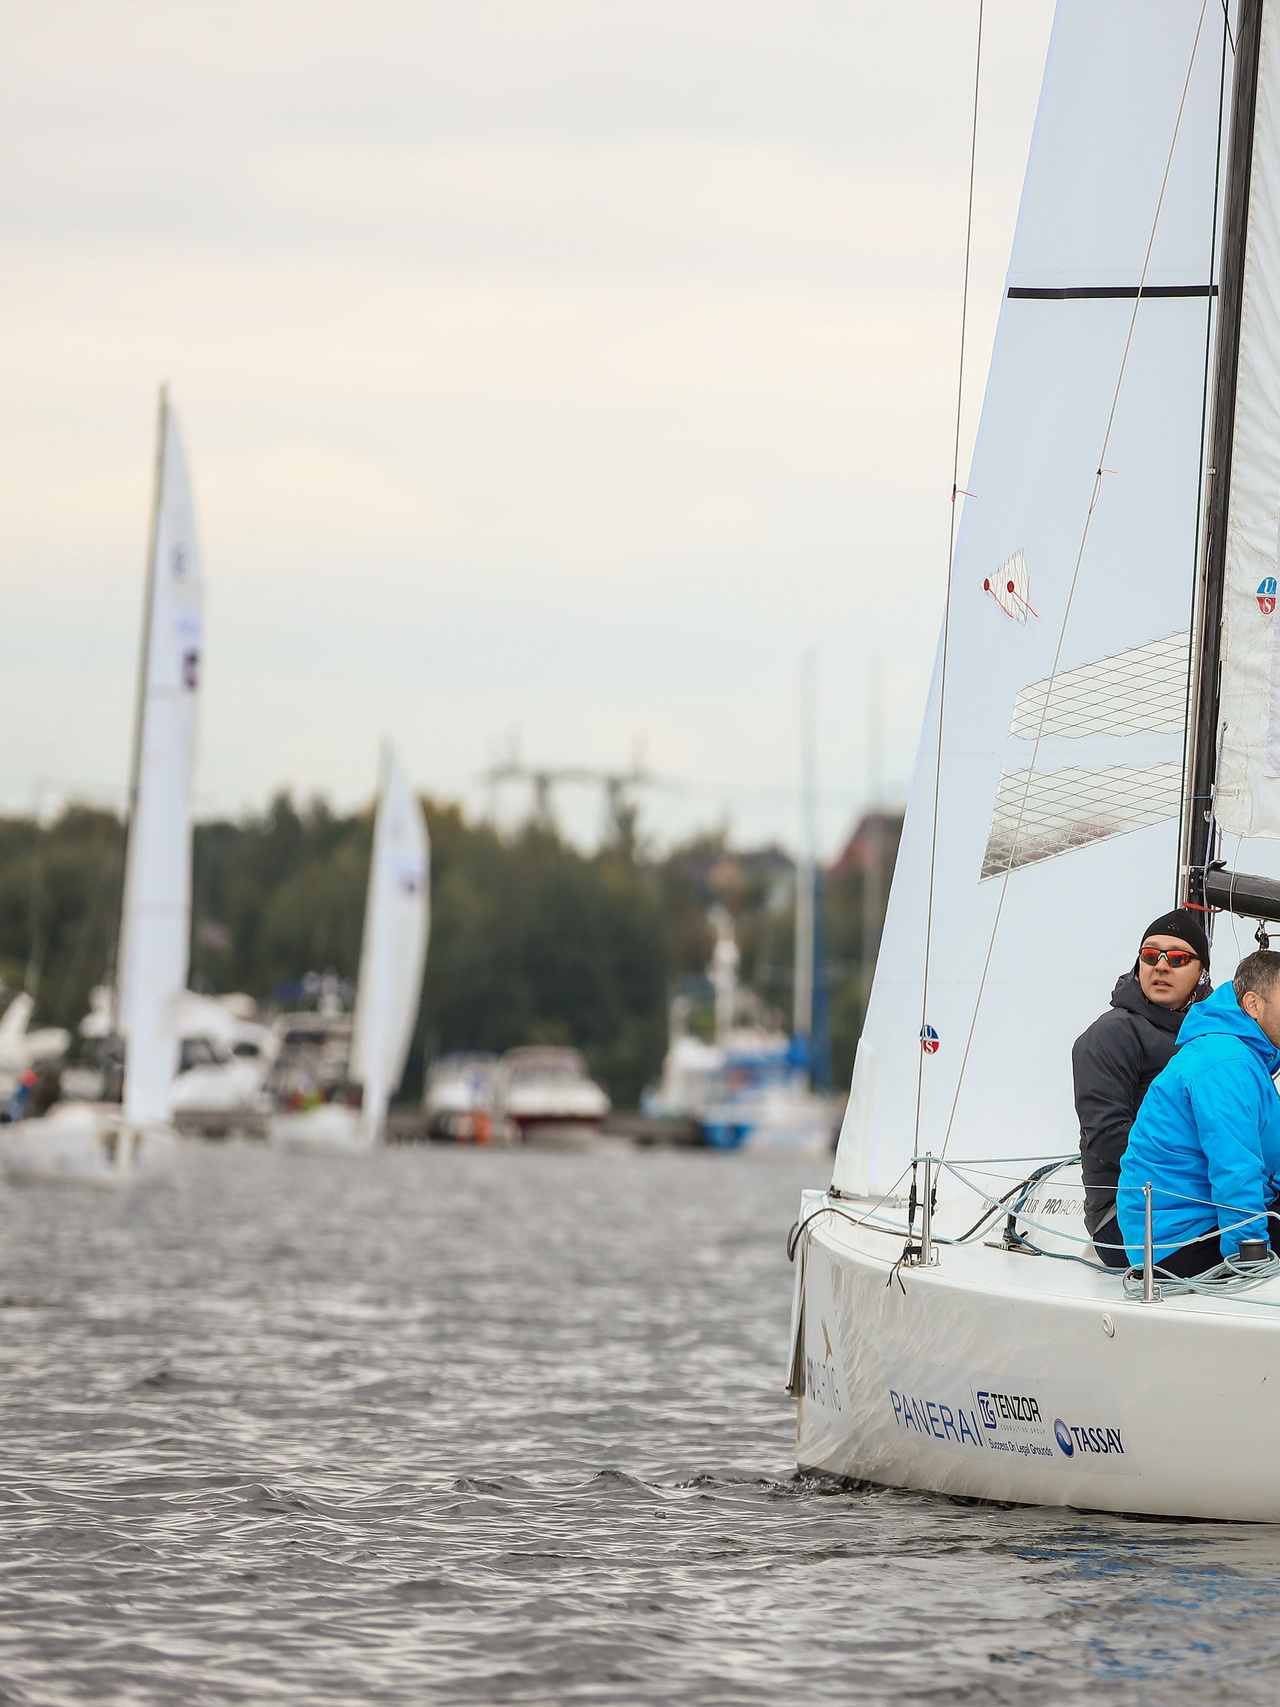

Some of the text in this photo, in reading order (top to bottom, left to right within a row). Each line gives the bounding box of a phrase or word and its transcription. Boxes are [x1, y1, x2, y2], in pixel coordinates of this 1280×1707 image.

[889, 1389, 984, 1447] PANERAI
[990, 1393, 1043, 1423] TENZOR
[1070, 1426, 1126, 1454] TASSAY
